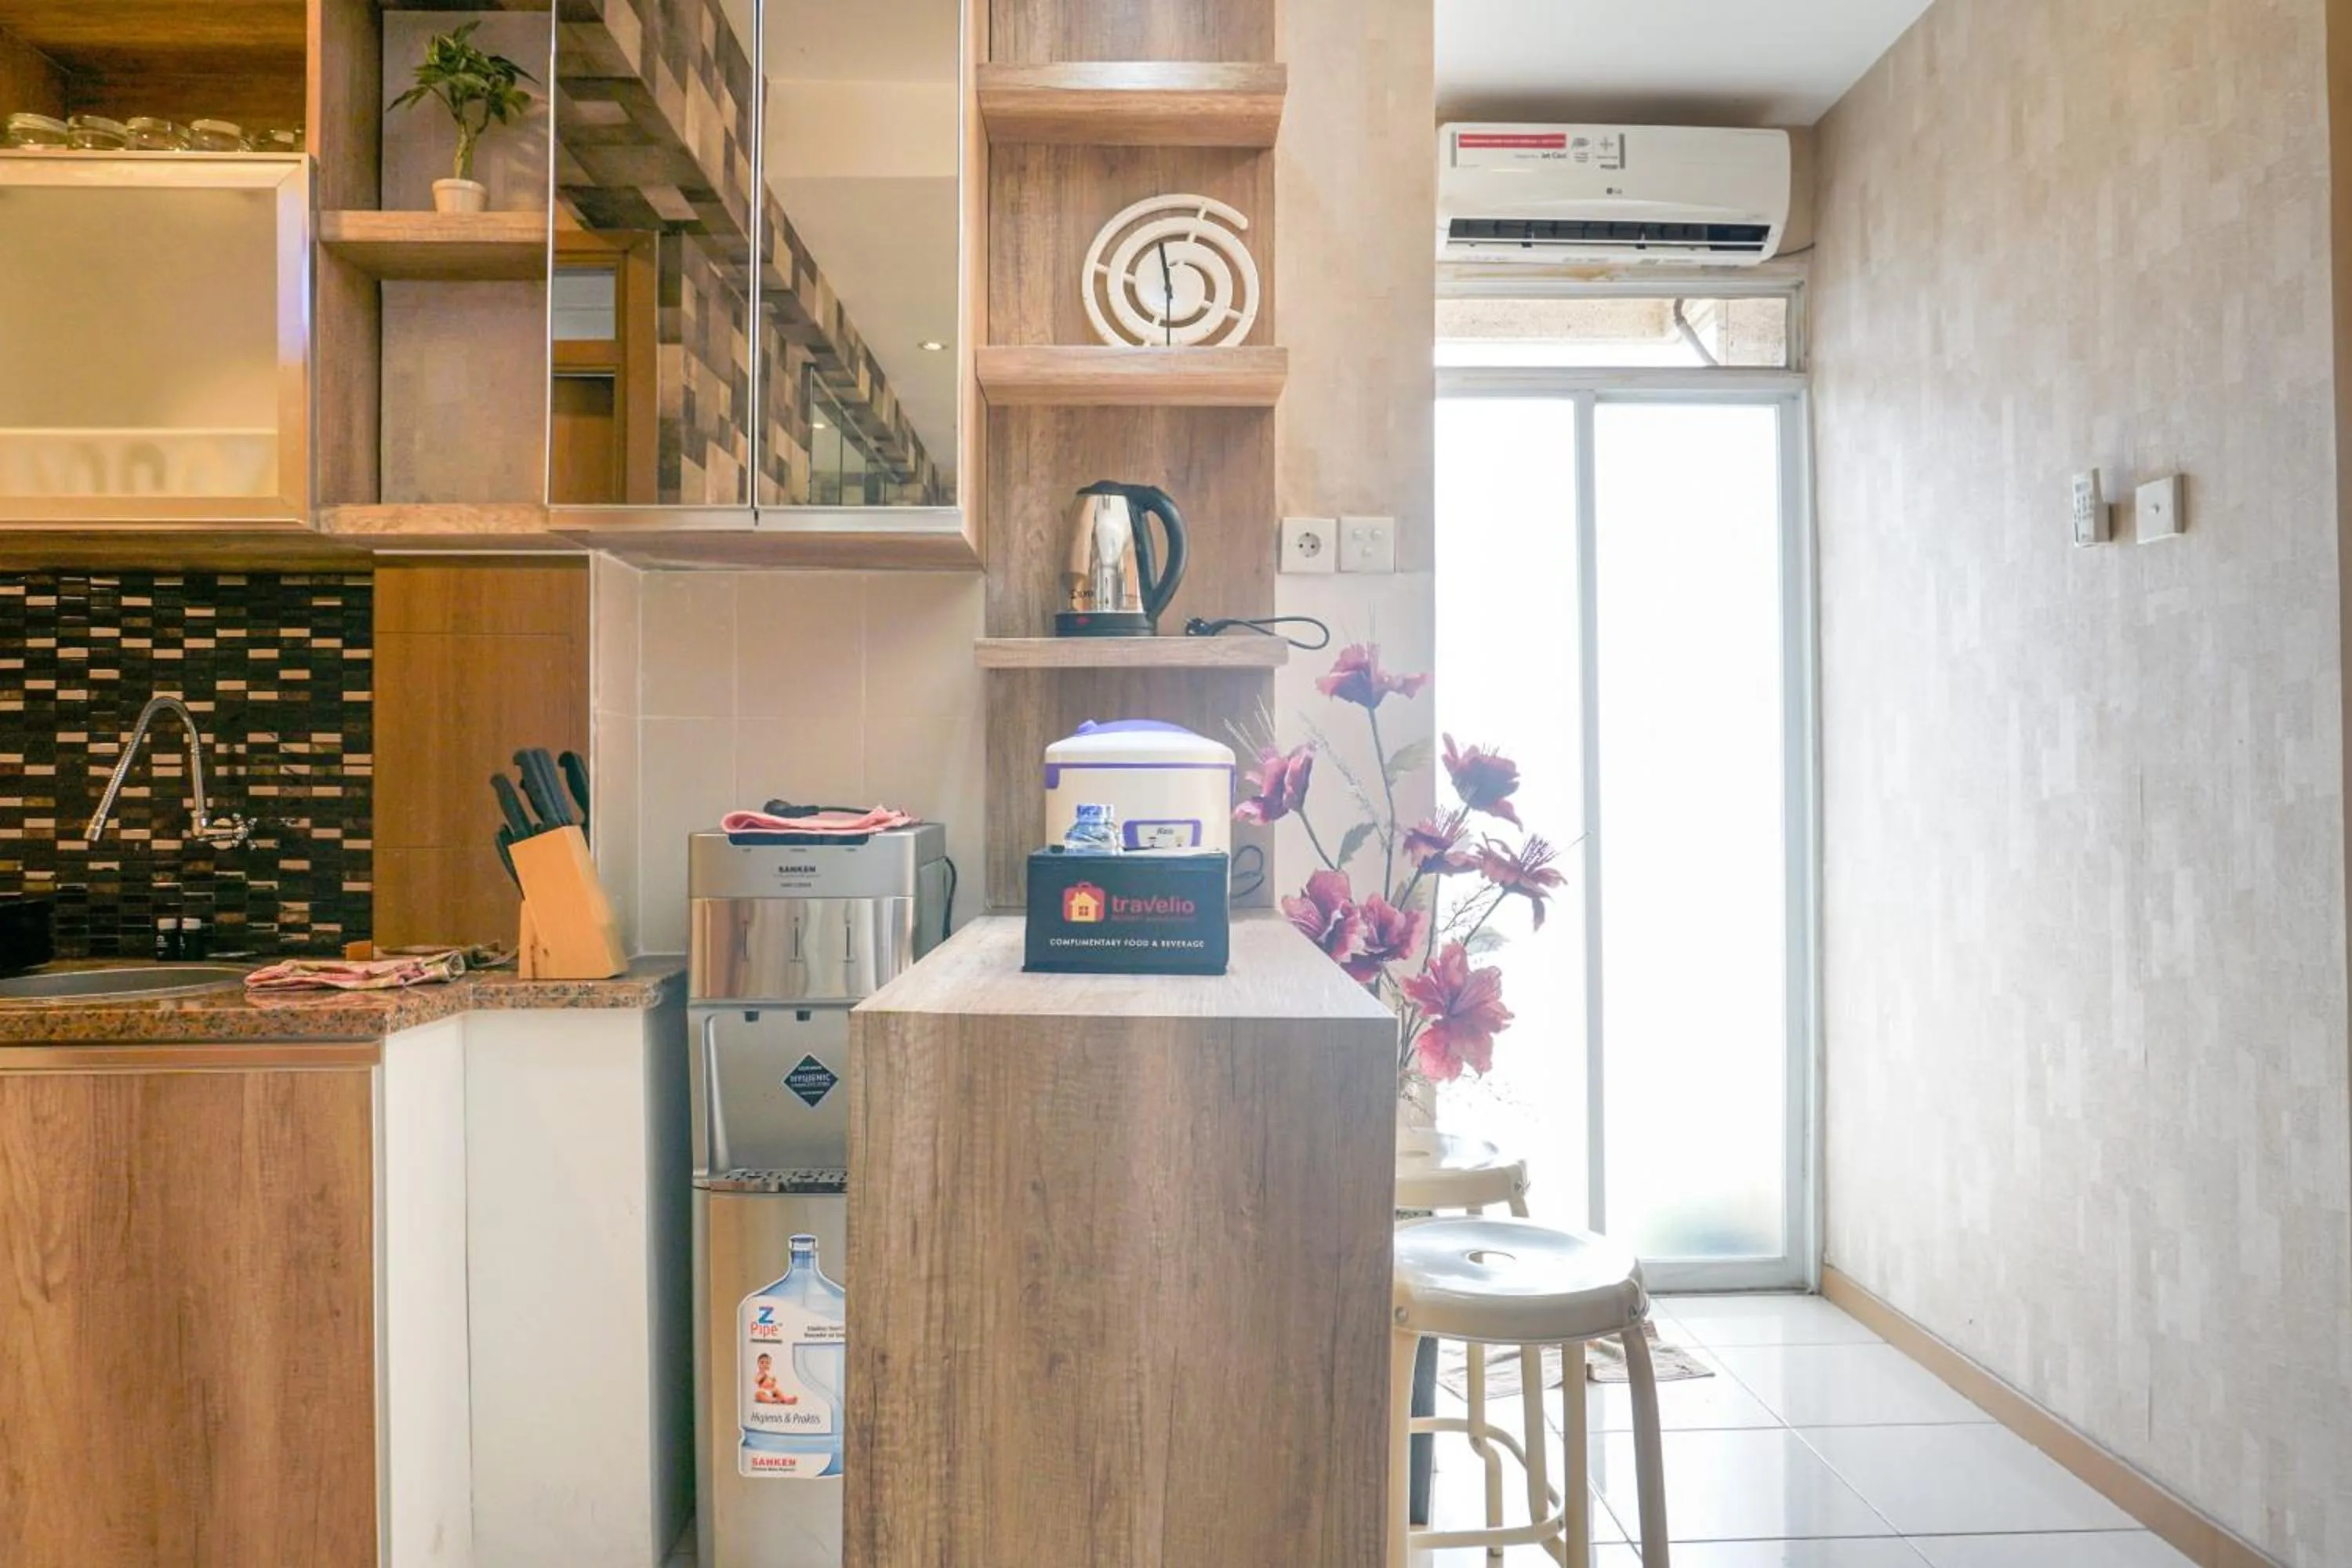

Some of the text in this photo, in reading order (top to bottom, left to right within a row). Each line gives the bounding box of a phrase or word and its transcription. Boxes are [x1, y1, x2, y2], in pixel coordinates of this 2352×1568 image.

[1112, 895, 1196, 914] travelio
[1123, 938, 1149, 947] FOOD
[1160, 939, 1205, 948] BEVERAGE
[758, 1306, 774, 1324] Z
[750, 1322, 779, 1338] Pipe
[785, 1414, 792, 1424] &
[752, 1457, 796, 1467] SANKEN
